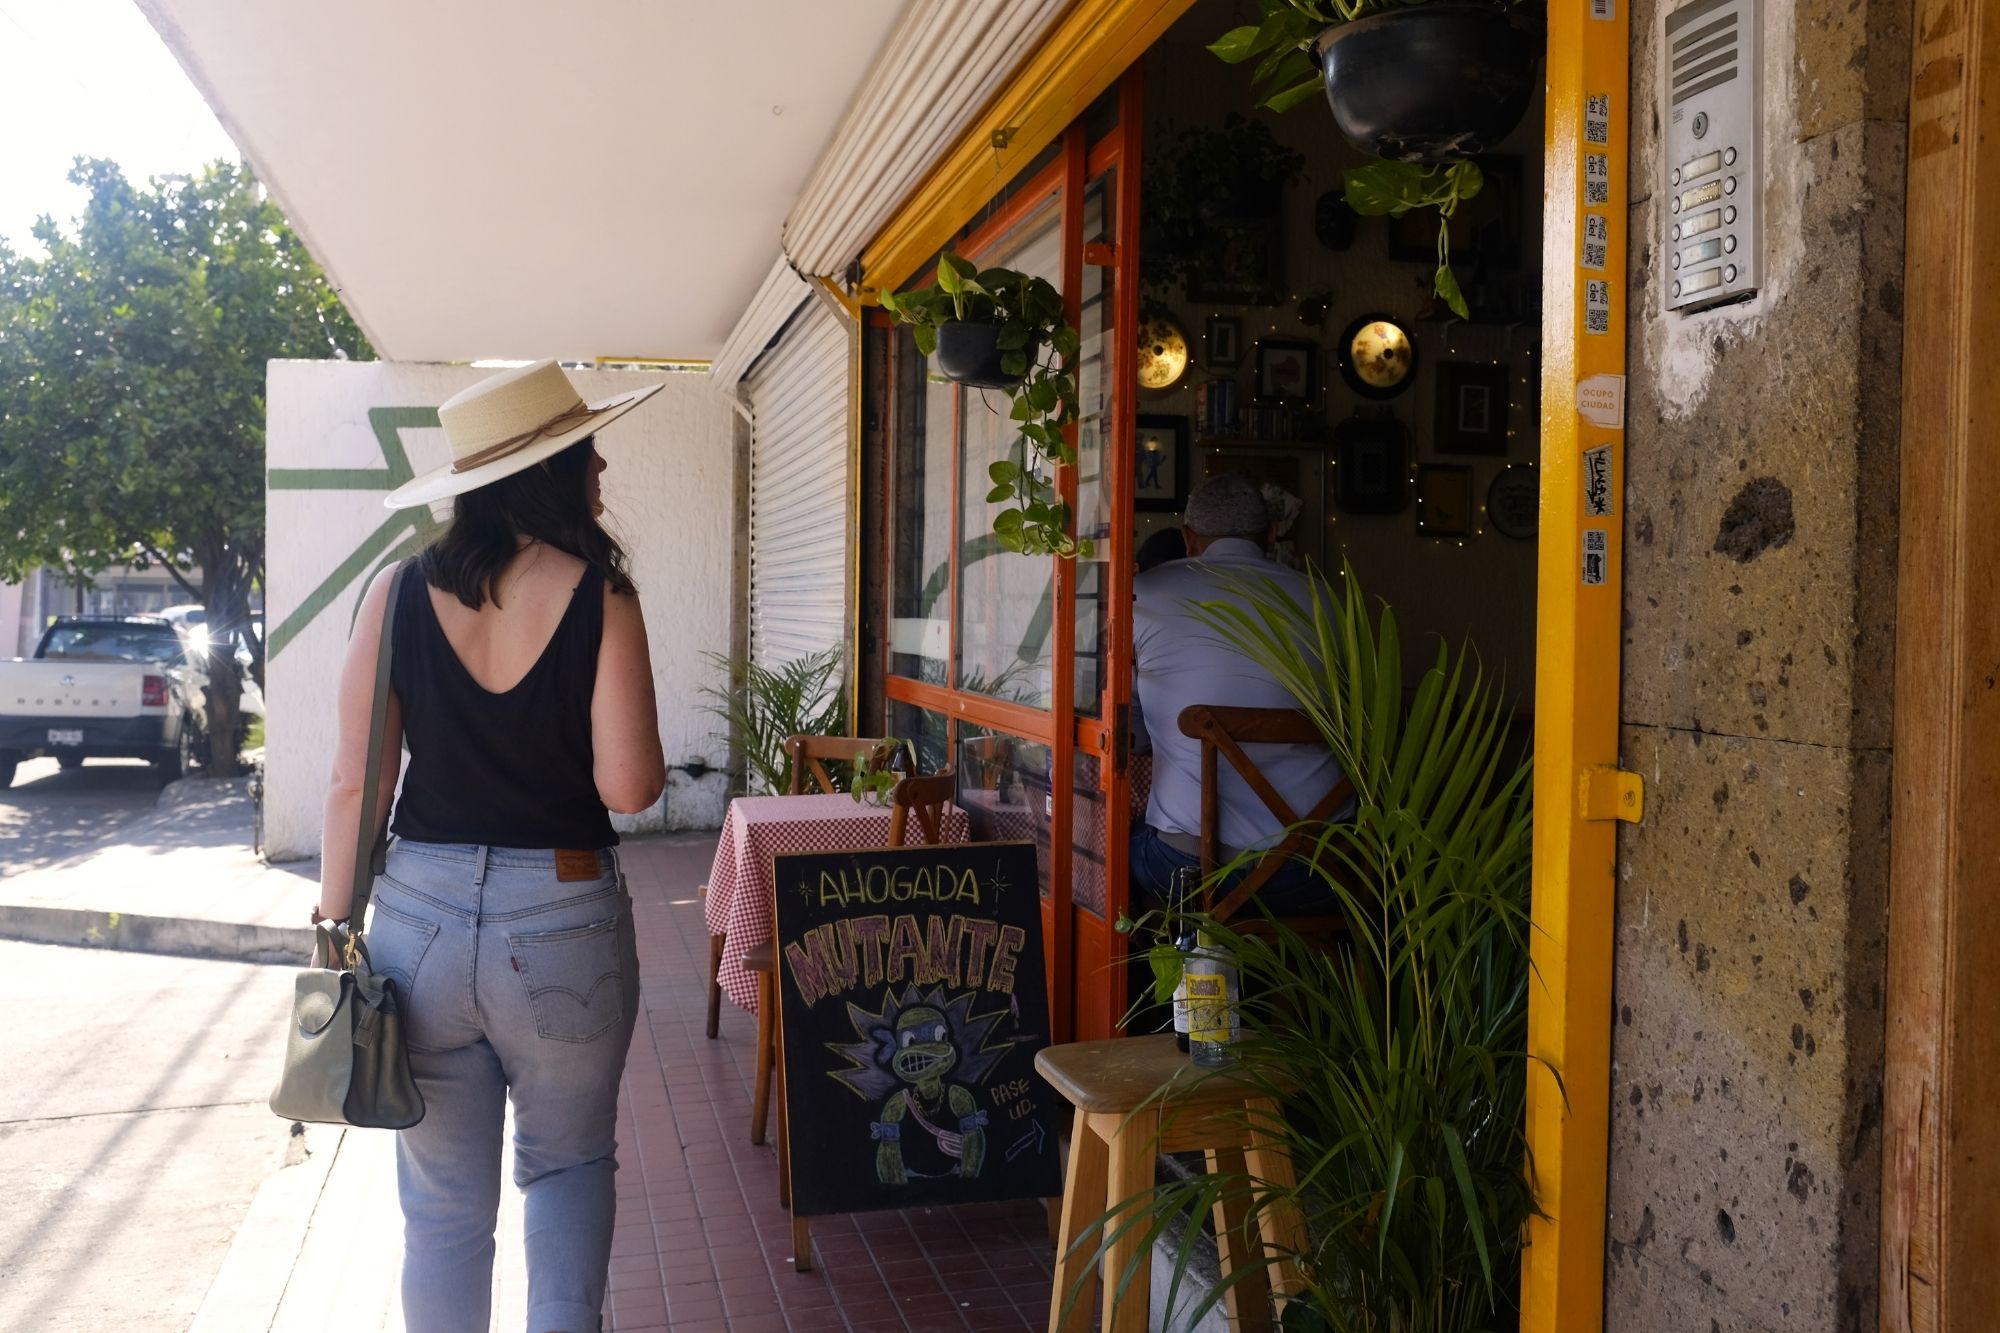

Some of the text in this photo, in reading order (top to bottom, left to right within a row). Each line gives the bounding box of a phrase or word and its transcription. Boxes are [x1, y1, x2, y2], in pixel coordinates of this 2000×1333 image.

[1588, 155, 1597, 174] ciel
[1588, 218, 1597, 237] ciel
[1590, 283, 1599, 302] ciel
[1583, 388, 1614, 398] OCUPO
[1581, 400, 1615, 410] CIUDAD
[820, 865, 980, 908] AHOGADA
[784, 914, 1025, 1008] MUTANTE
[991, 1078, 1030, 1105] PASE
